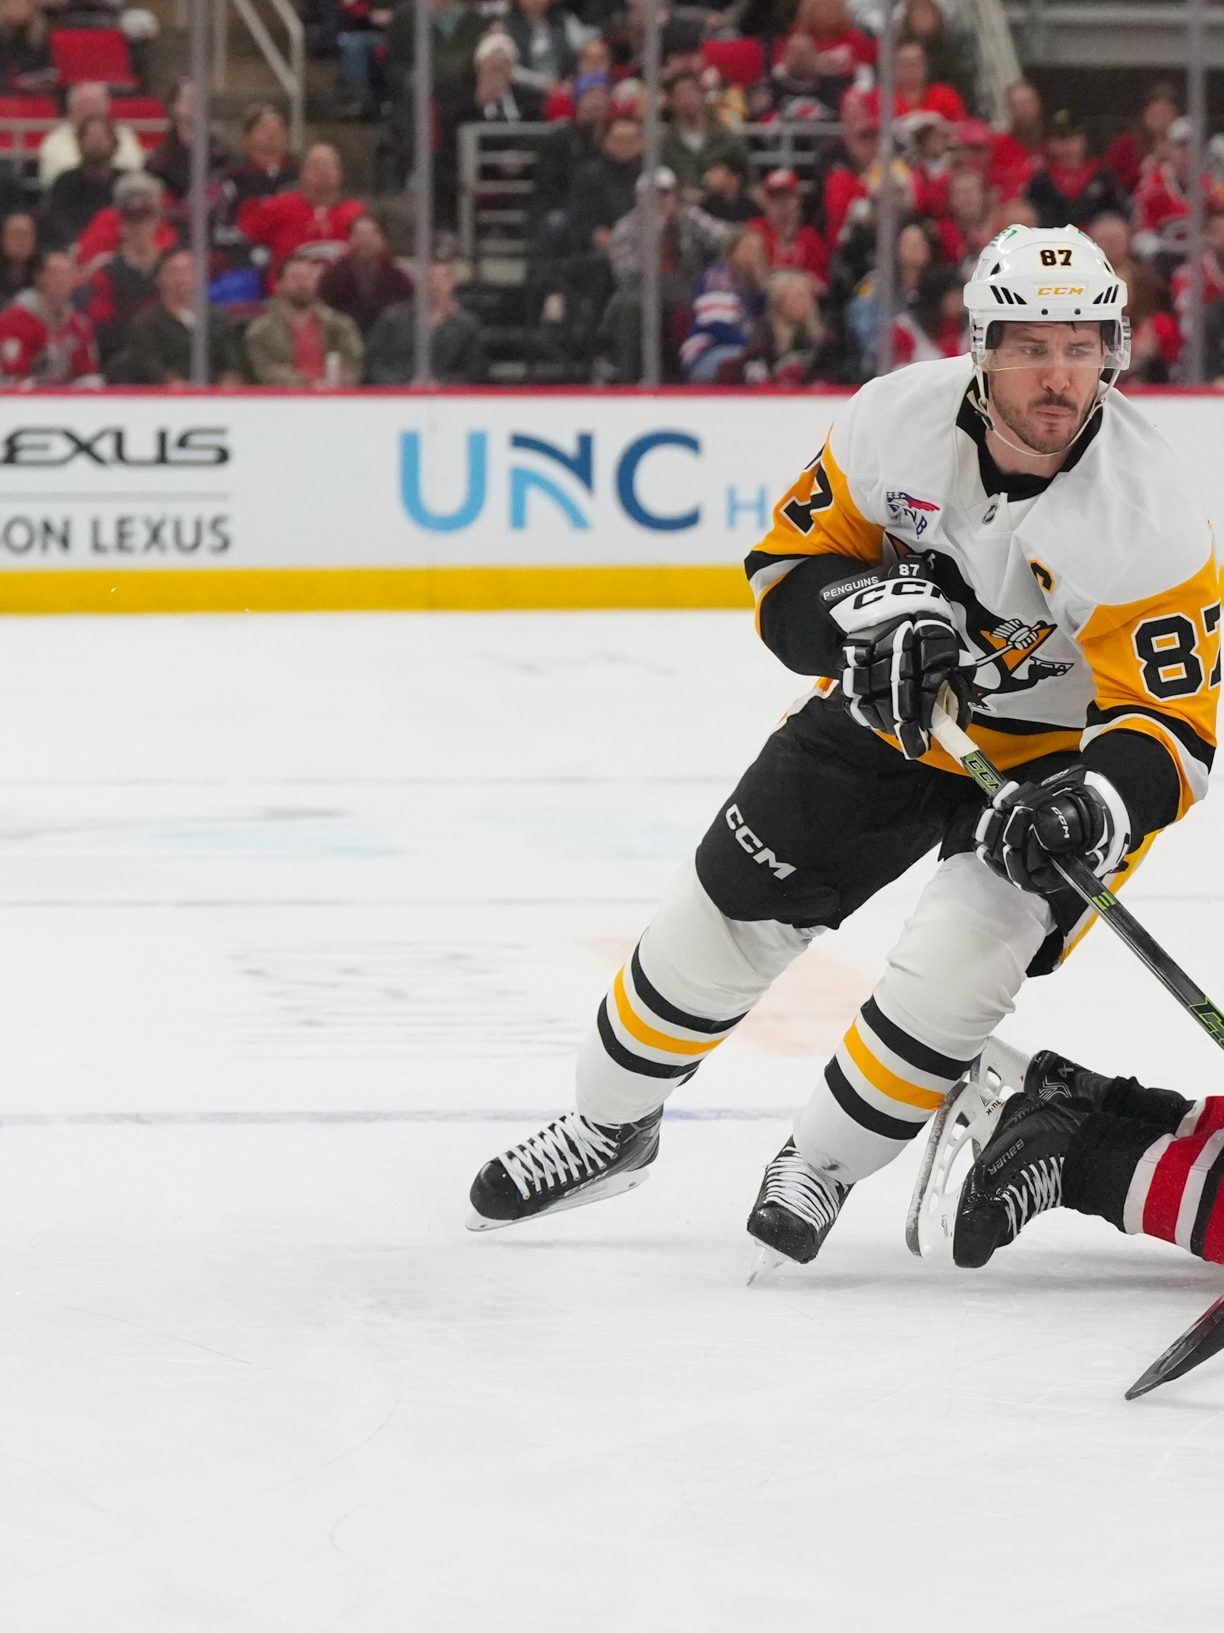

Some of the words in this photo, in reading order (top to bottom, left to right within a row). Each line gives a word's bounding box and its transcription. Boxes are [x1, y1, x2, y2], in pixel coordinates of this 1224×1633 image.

[1040, 249, 1073, 267] 87
[1037, 286, 1085, 297] CCM
[0, 426, 230, 465] EXUS
[398, 429, 703, 534] UNC
[91, 515, 231, 554] LEXUS
[899, 563, 920, 577] 87
[822, 576, 879, 601] PENGUINS
[1050, 806, 1071, 839] CCM
[725, 803, 798, 881] CCM
